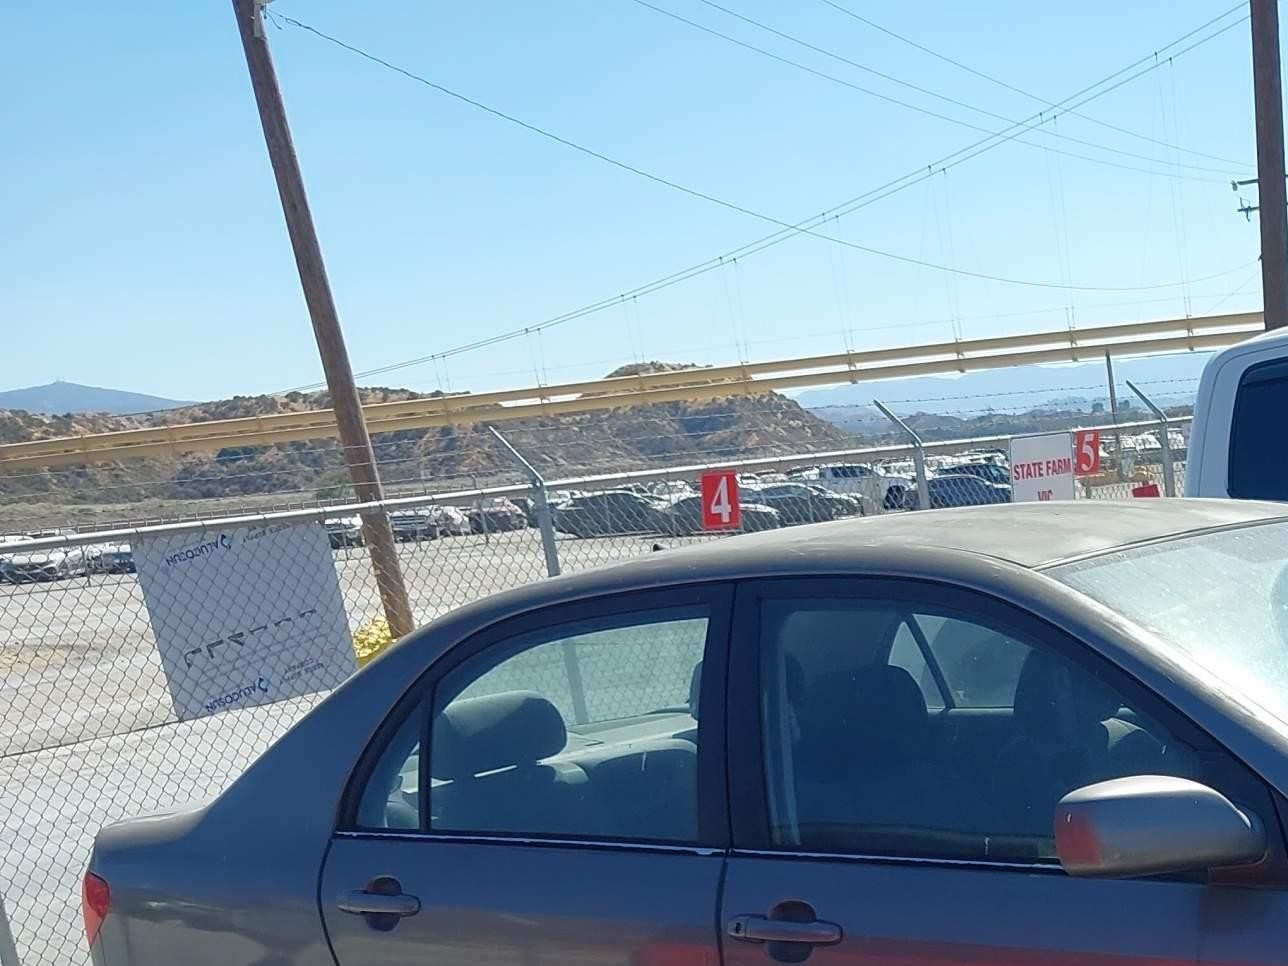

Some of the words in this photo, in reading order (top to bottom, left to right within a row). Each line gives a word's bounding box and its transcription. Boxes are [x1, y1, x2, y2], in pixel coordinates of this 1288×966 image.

[1013, 461, 1044, 480] STATE
[1046, 458, 1071, 476] FARM
[1081, 433, 1095, 471] 5
[711, 475, 732, 523] 4
